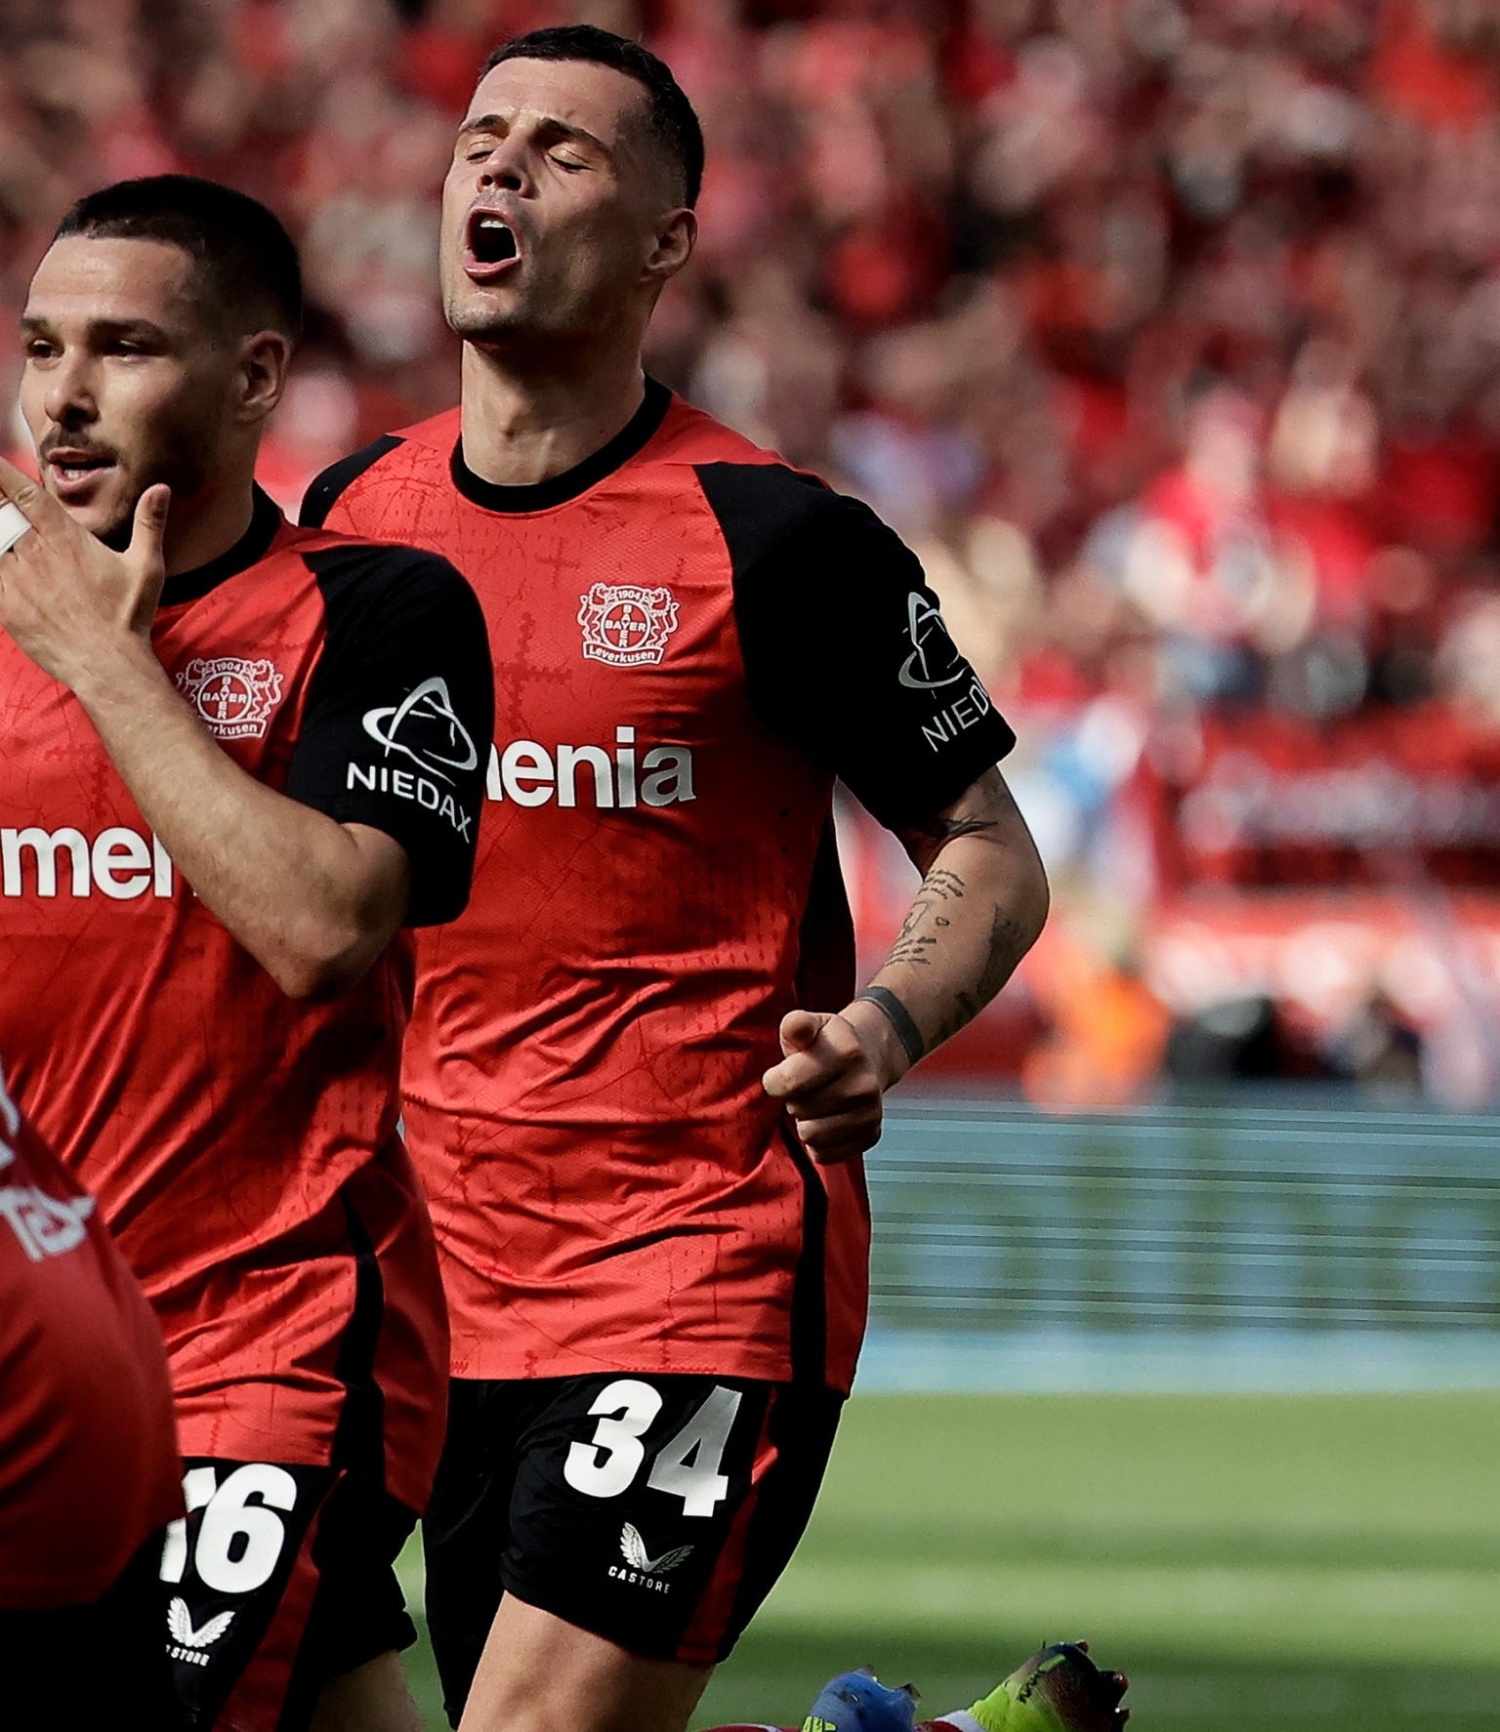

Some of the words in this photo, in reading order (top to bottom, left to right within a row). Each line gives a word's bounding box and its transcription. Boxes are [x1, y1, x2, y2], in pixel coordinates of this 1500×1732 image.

[618, 589, 642, 600] 1904
[604, 619, 647, 633] BAYER
[588, 643, 656, 663] Leverkusen
[216, 661, 241, 673] 1904
[202, 692, 248, 704] BAYER
[346, 761, 472, 844] NIEDAX
[563, 1379, 743, 1518] 34
[159, 1462, 298, 1594] 16
[607, 1565, 671, 1594] CASTORE
